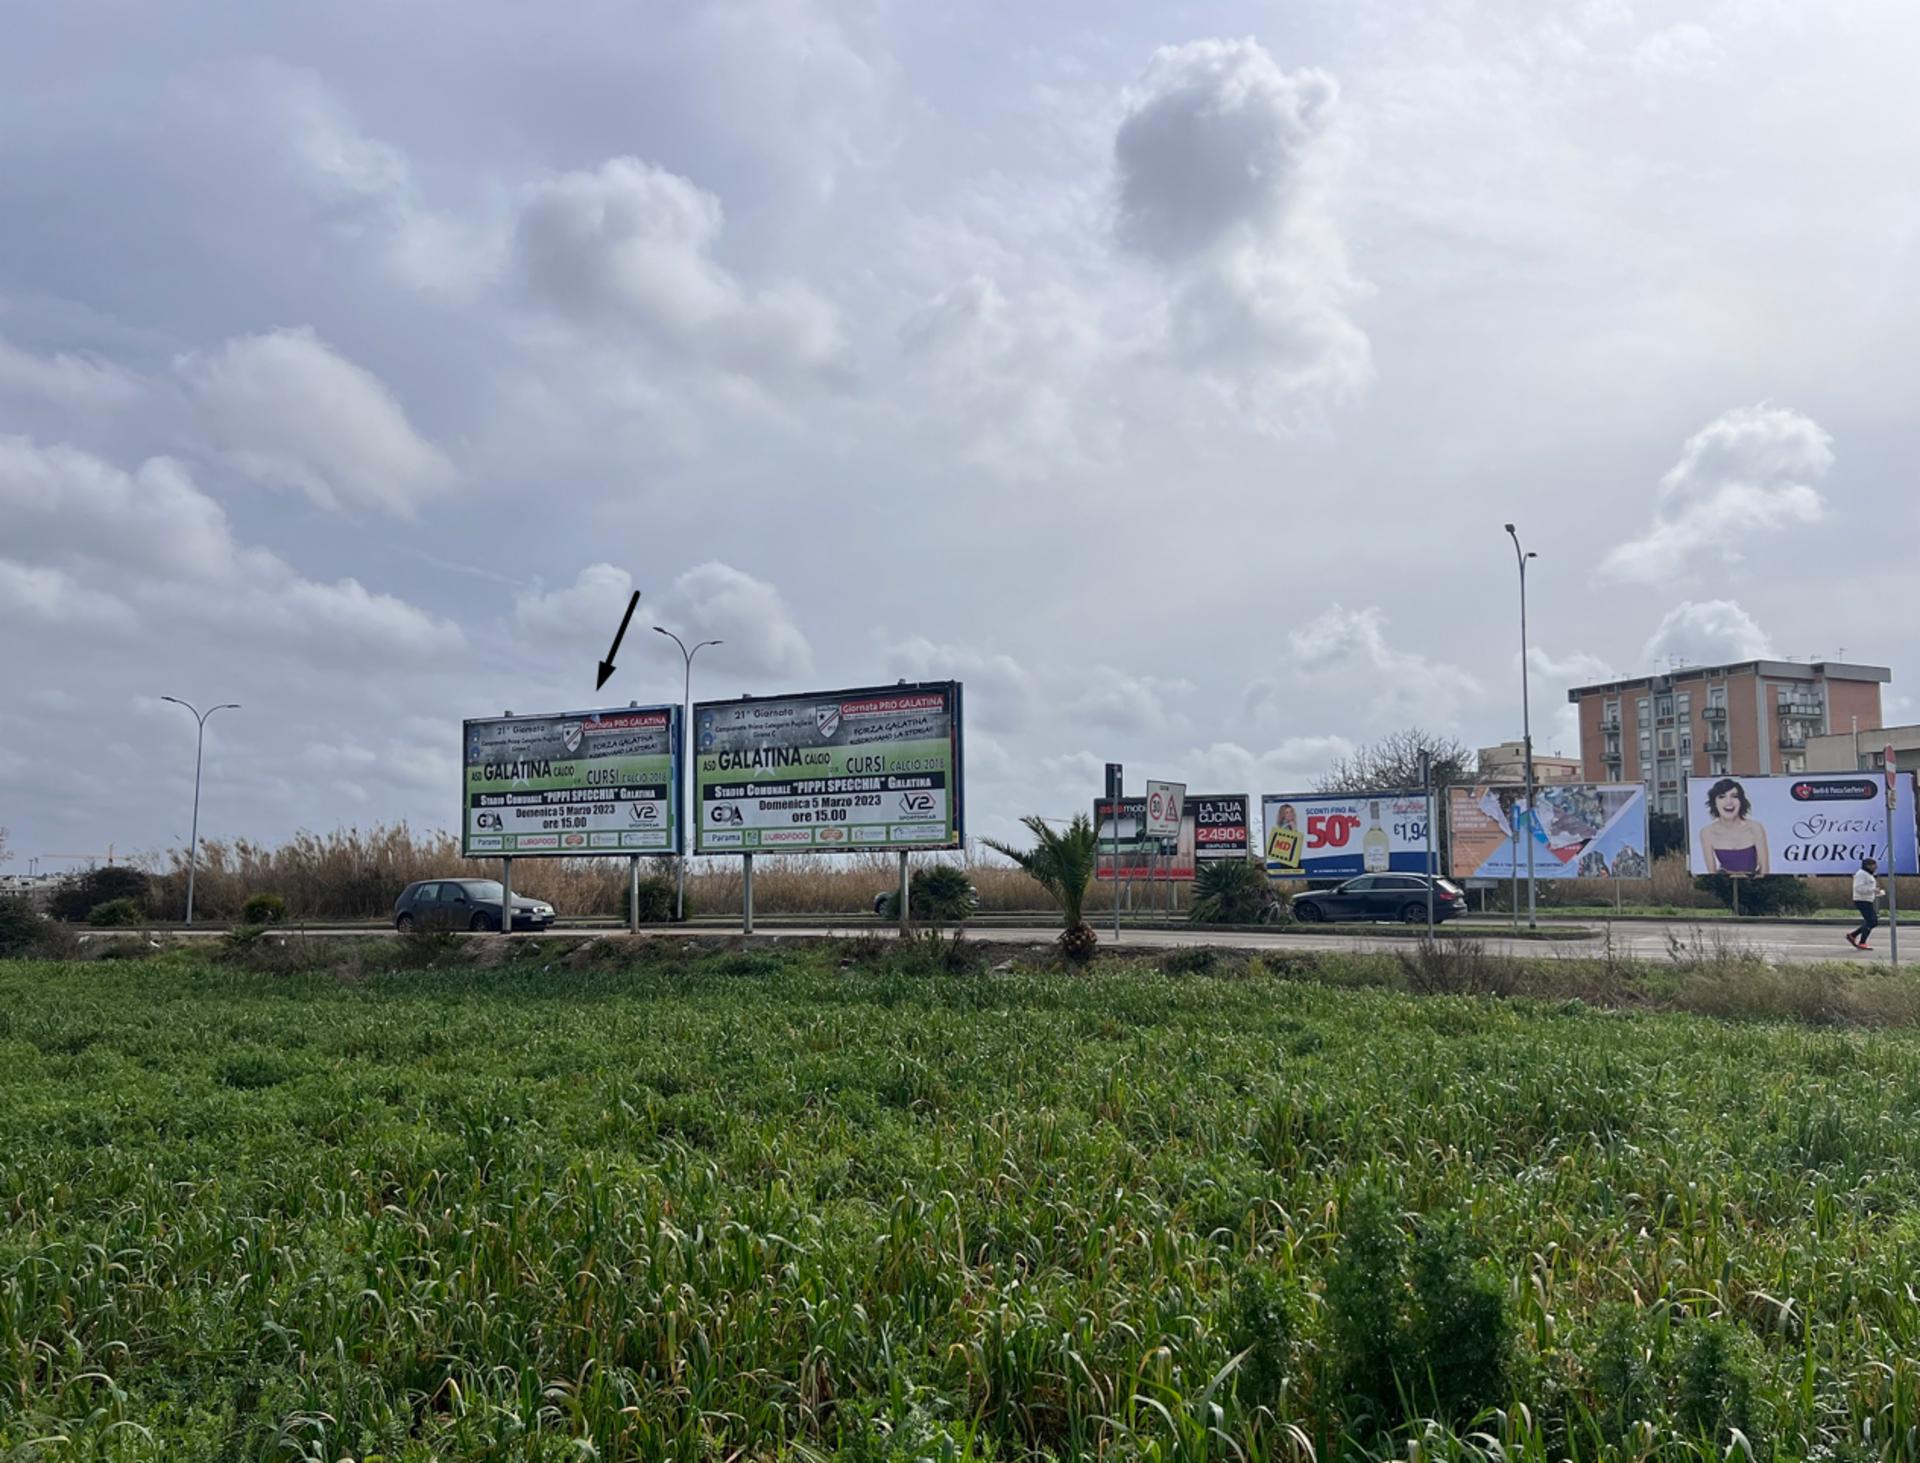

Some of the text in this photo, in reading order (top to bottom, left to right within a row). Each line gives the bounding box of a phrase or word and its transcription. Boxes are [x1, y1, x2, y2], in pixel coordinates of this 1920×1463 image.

[843, 697, 943, 713] Giornata PRO GALATINA
[753, 709, 793, 718] Giornata
[614, 719, 628, 728] PRO
[630, 717, 666, 726] GALATINA
[854, 717, 927, 735] FORZA GALATINA
[593, 735, 653, 750] FORZA GALATINA
[703, 747, 830, 771] ASD GALATINA CALCIO
[846, 756, 885, 773] CURSI
[890, 760, 921, 771] CALCIO
[471, 760, 575, 781] ASD GALATINA CALCIO
[586, 769, 619, 784] CURSI
[622, 773, 646, 782] CALCIO
[827, 777, 885, 792] SPECCHIA"
[572, 788, 618, 801] SPECCHIA"
[904, 793, 933, 810] V2
[759, 795, 881, 810] Domenica 5 Marzo 2023
[1199, 802, 1241, 812] LA TUA
[516, 804, 615, 818] Domenica 5 Marzo 2023
[792, 809, 846, 822] ore 15.00
[1199, 812, 1242, 822] CUCINA
[1305, 807, 1329, 815] SCONTI
[1330, 806, 1346, 814] FINO
[543, 817, 587, 829] ore 15.00
[1792, 813, 1884, 839] Grazie
[1198, 828, 1245, 841] 2.490€
[1306, 815, 1360, 848] 50%
[1274, 840, 1291, 851] MD
